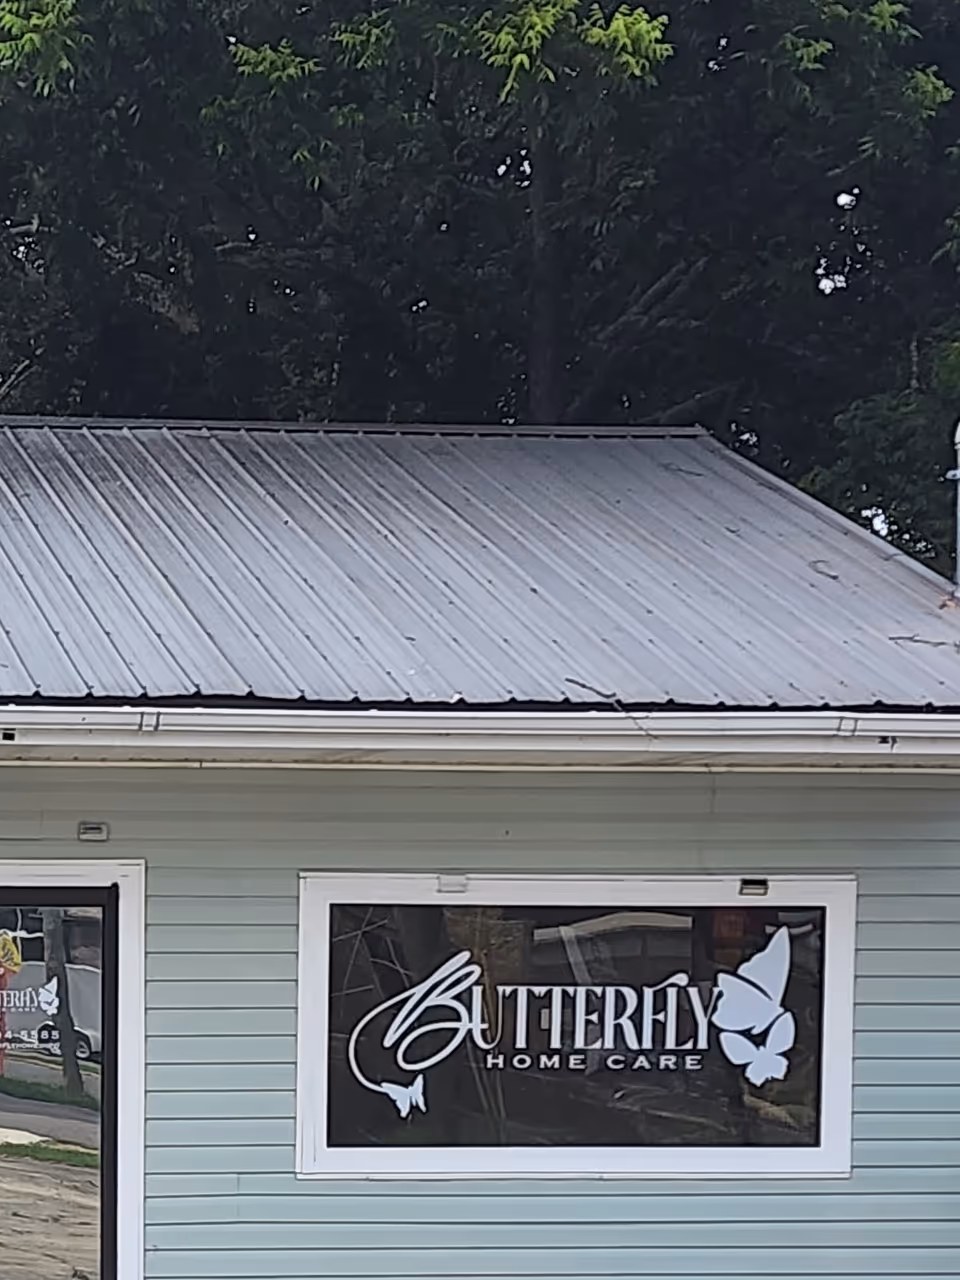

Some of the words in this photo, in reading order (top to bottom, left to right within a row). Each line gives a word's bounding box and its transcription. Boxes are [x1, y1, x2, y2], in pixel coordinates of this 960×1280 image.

[349, 950, 722, 1093] BUTTERFLY
[486, 1054, 586, 1070] HOME
[607, 1054, 703, 1070] CARE
